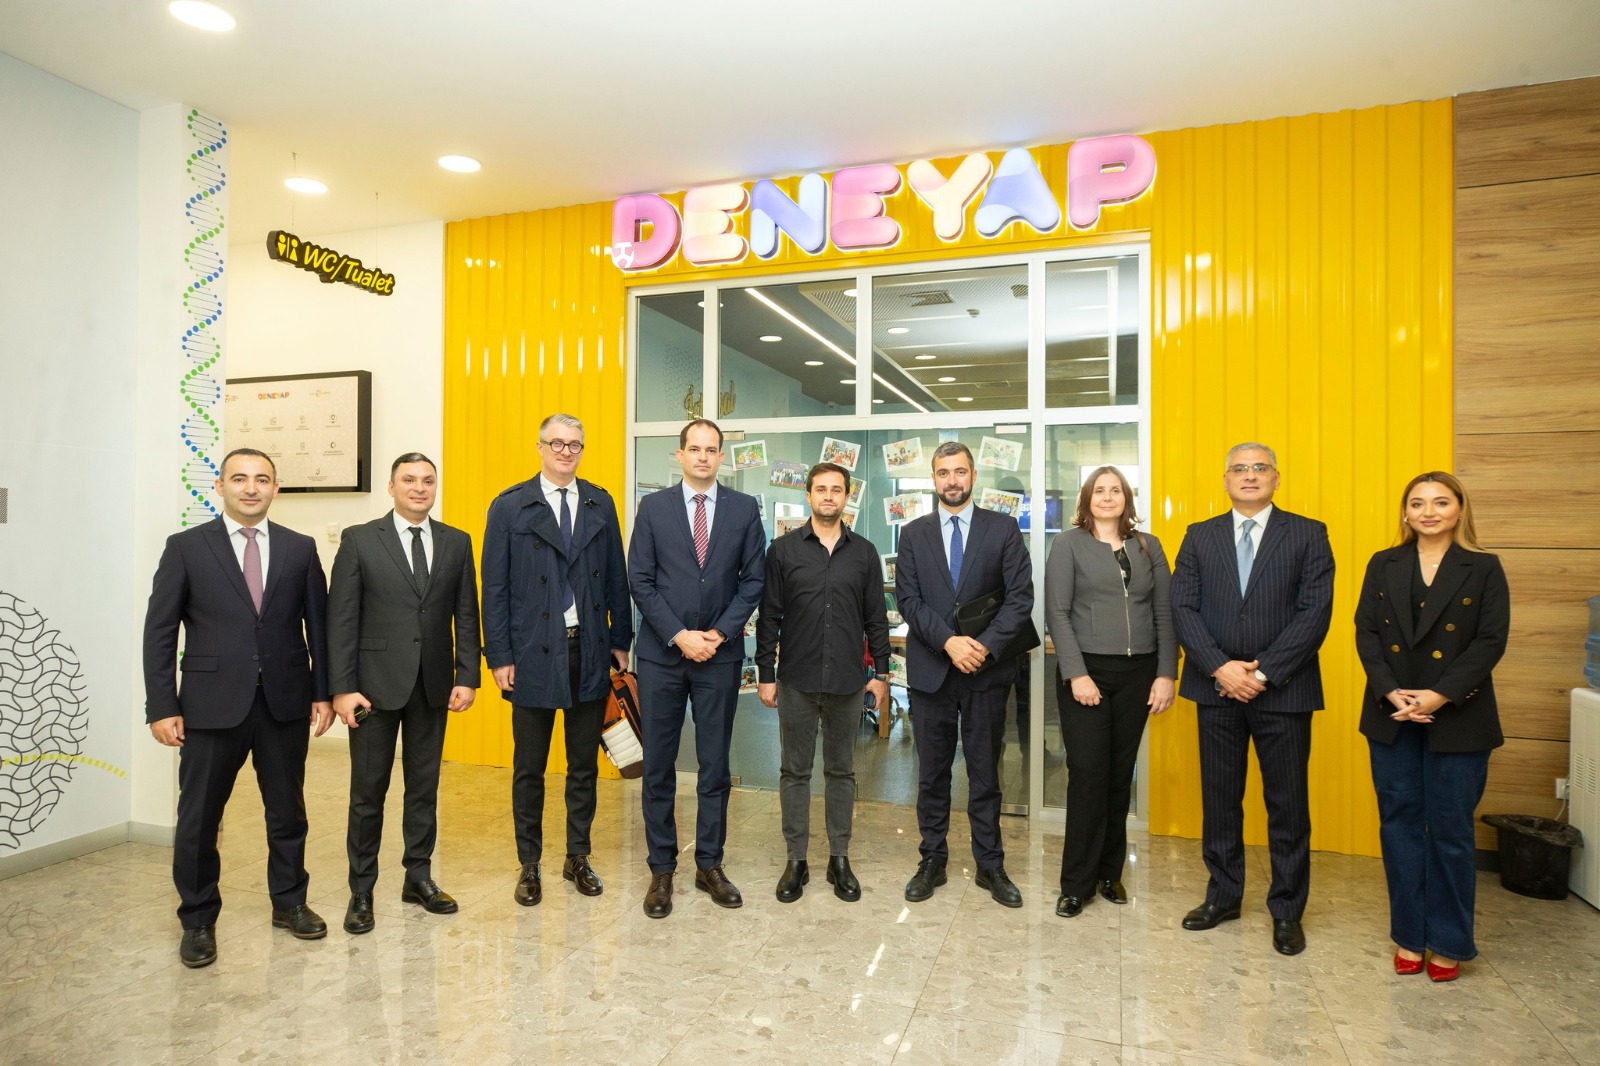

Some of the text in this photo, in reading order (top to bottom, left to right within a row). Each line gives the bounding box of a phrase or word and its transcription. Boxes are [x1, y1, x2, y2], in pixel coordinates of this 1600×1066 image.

[611, 134, 1156, 270] DENEYAP
[303, 248, 393, 294] WC/Tualet
[258, 392, 290, 400] DENEYAP
